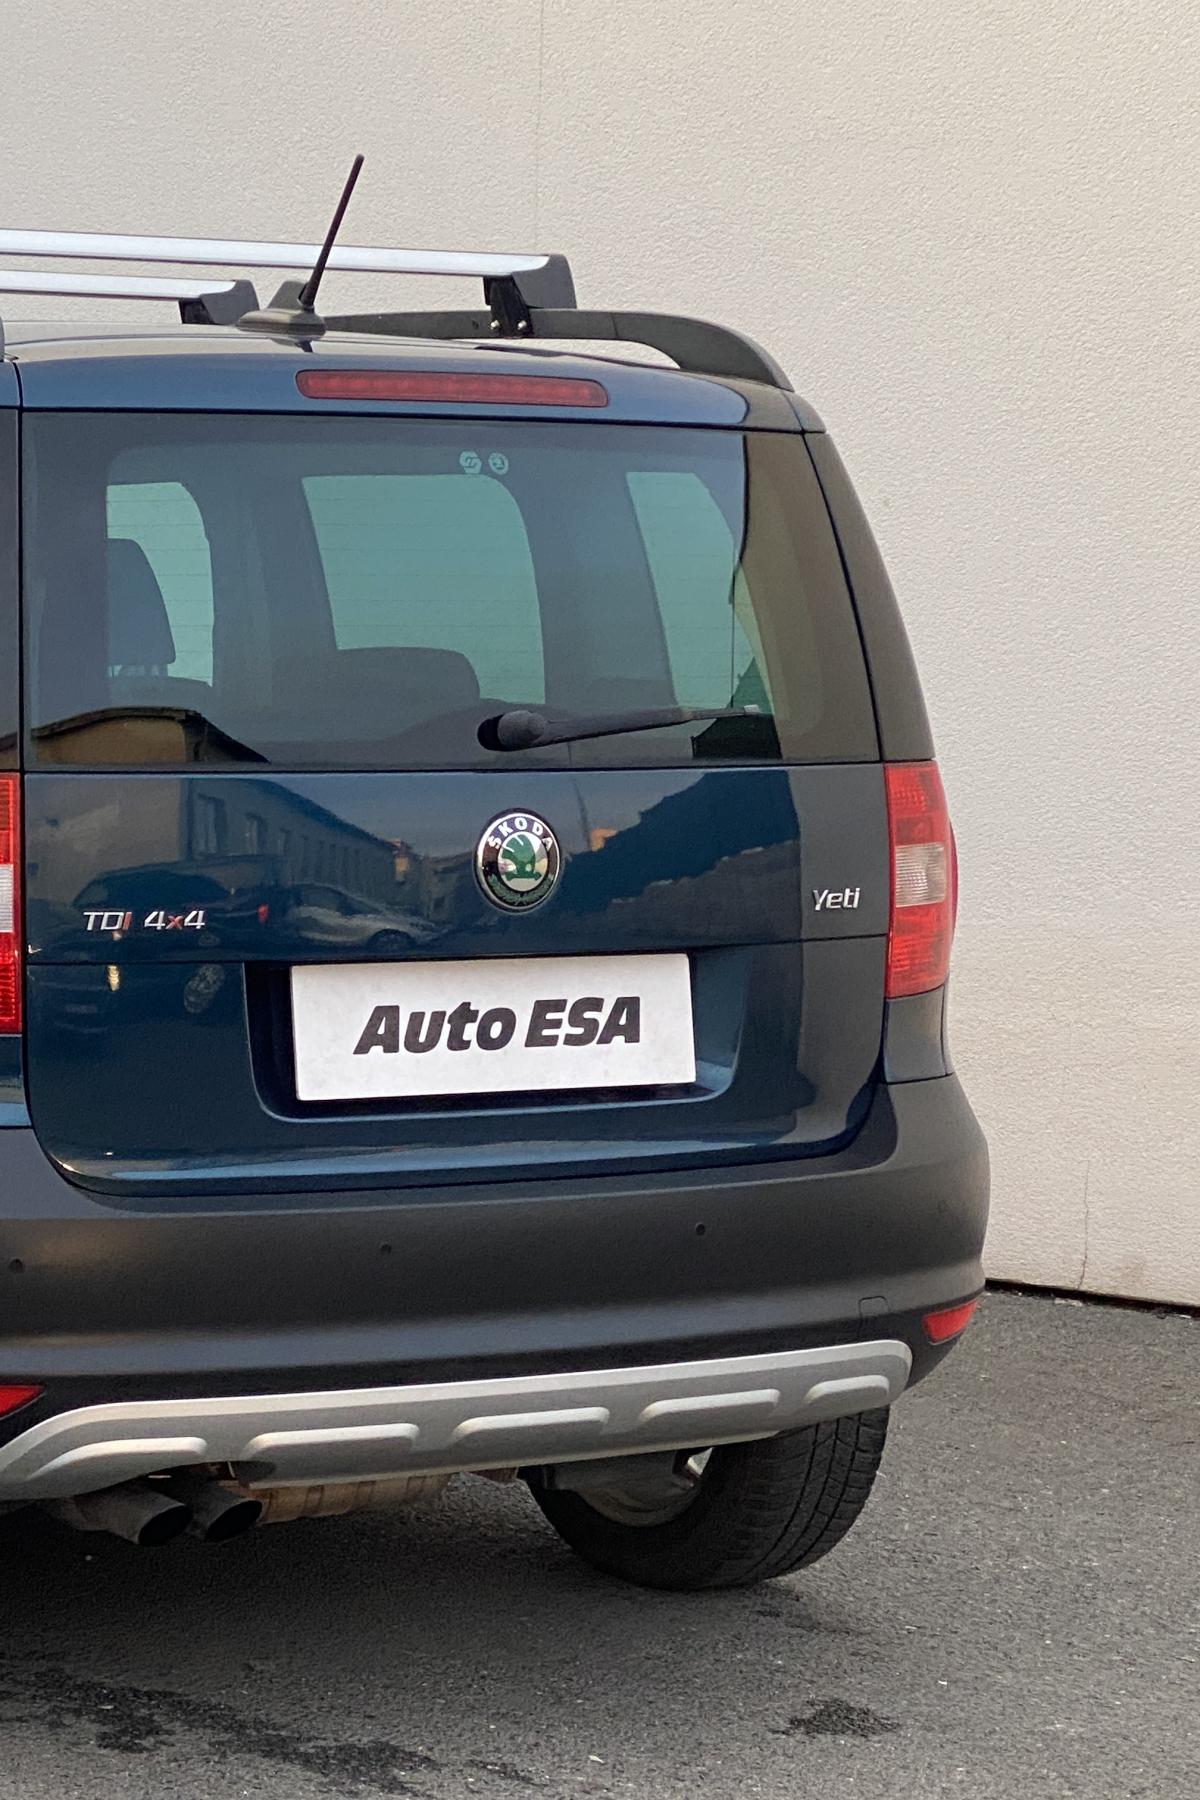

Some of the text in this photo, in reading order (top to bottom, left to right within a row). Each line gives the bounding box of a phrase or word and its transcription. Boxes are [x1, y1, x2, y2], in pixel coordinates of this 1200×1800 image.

[812, 887, 861, 911] Yeti
[83, 910, 205, 931] TDI 4x4
[353, 996, 641, 1055] Auto ESA
